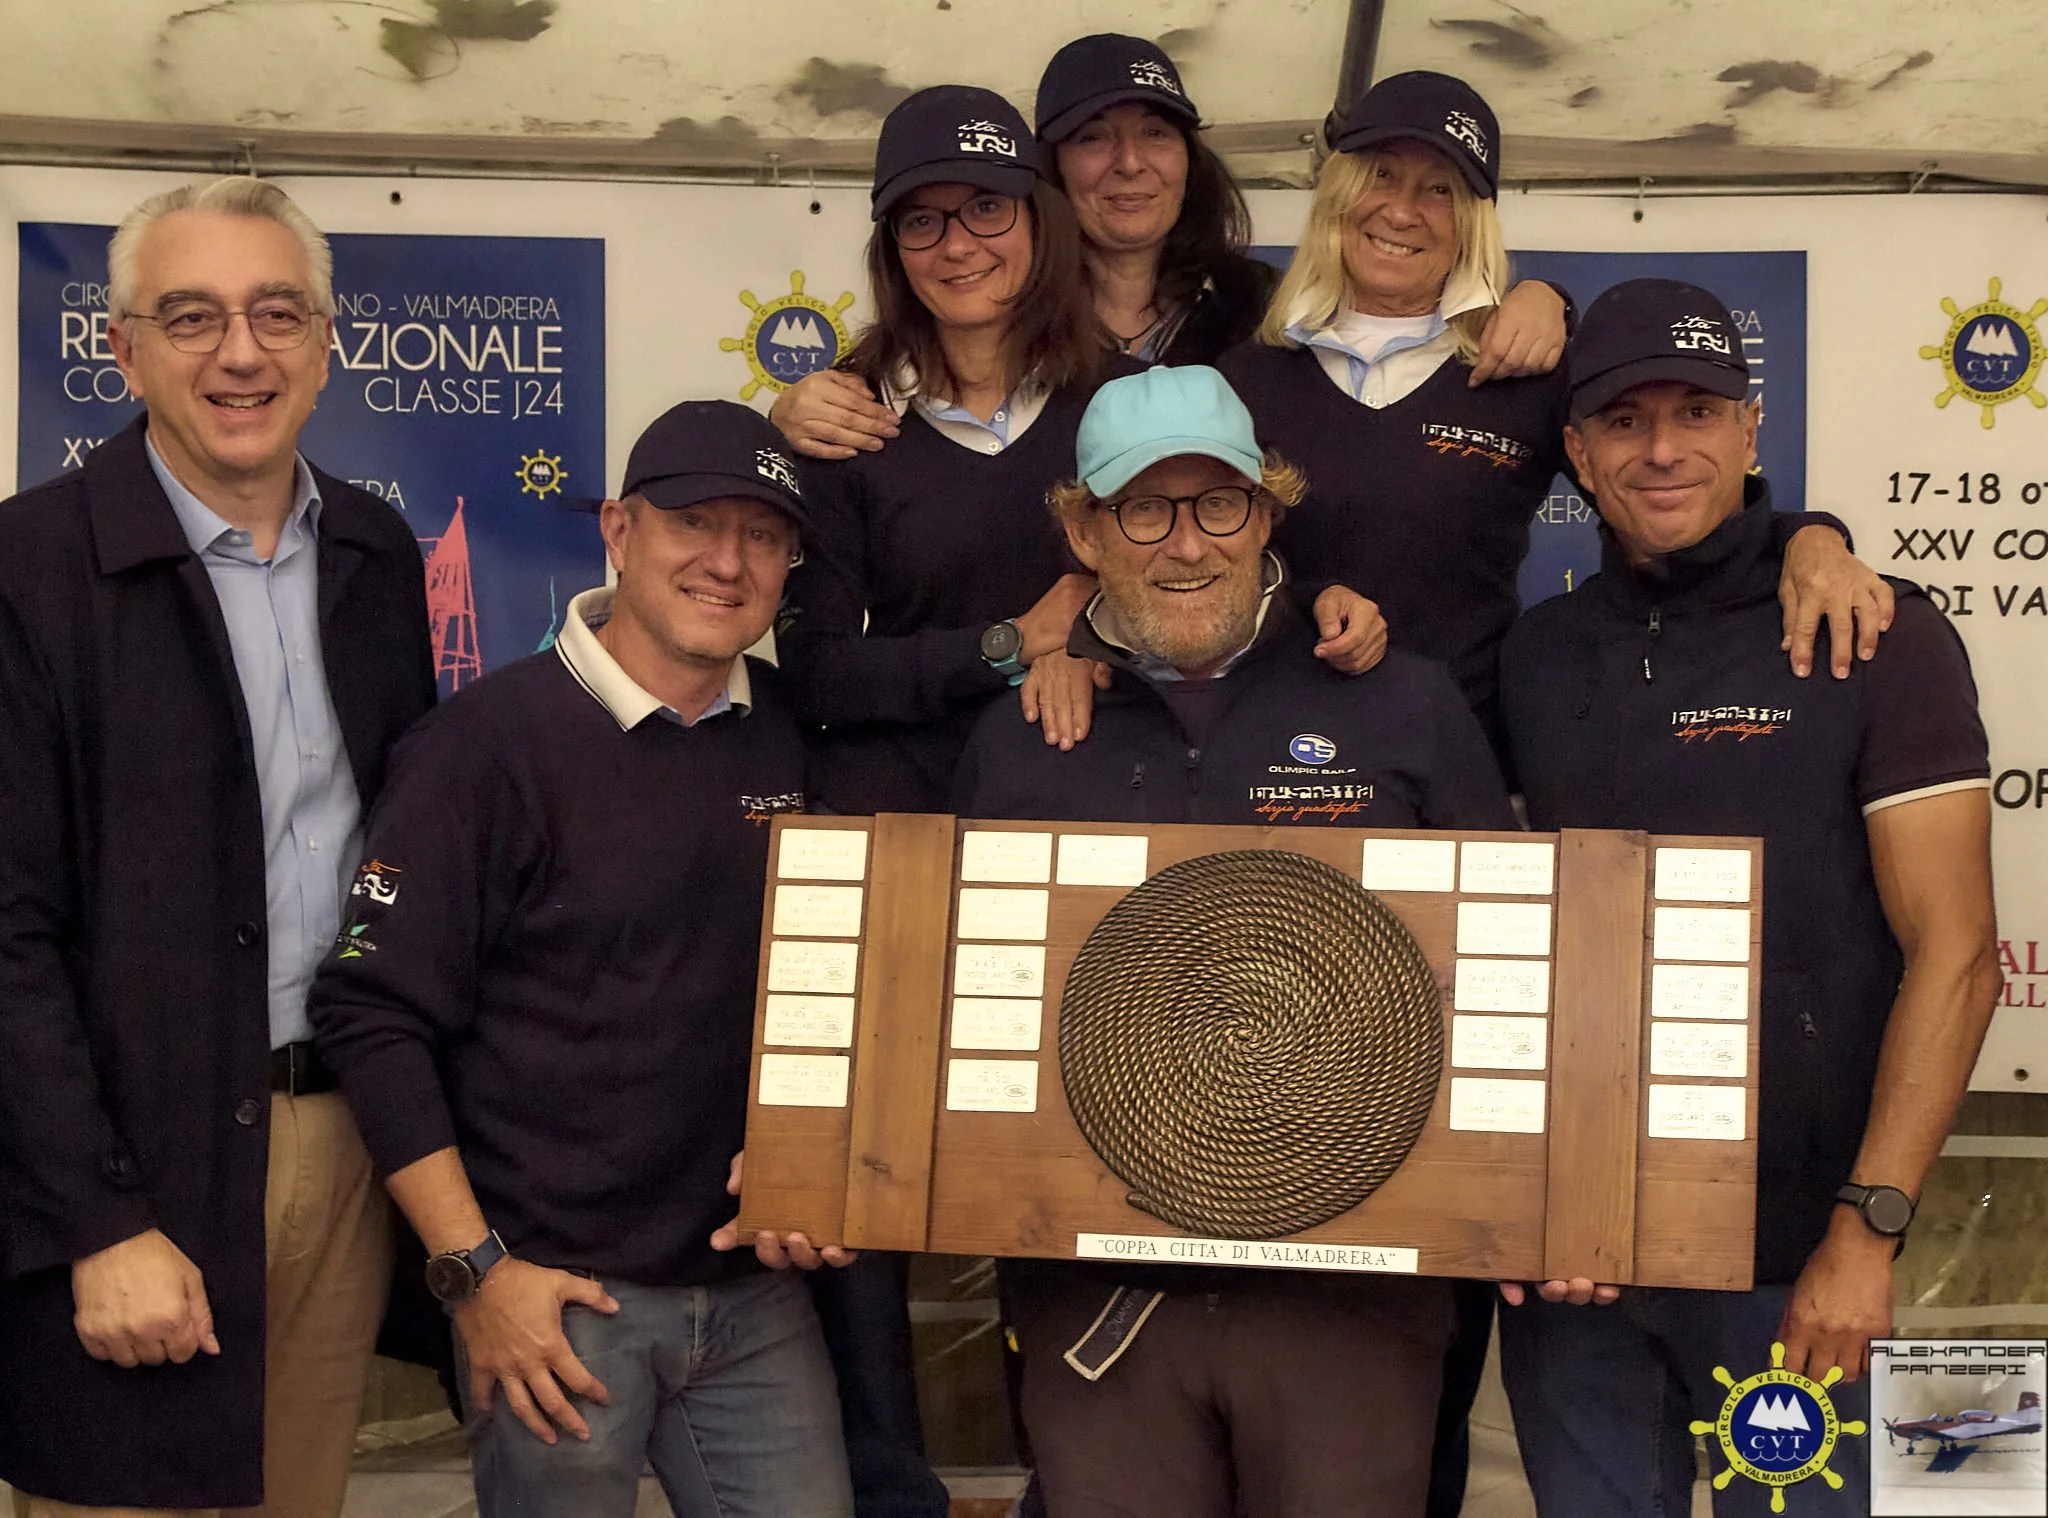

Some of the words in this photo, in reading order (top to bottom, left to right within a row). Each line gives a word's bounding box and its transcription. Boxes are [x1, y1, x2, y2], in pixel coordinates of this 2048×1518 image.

[403, 295, 560, 320] VALMADRERA
[63, 366, 135, 403] CO
[364, 376, 500, 413] CLASSE
[512, 380, 564, 420] J24
[1888, 472, 2001, 504] 17-18
[1892, 529, 1974, 560] XXV
[1993, 529, 2048, 560] CO
[1993, 585, 2048, 616] VA
[1268, 765, 1319, 775] OLIMPIC
[1996, 982, 2046, 1008] LL
[1232, 1245, 1250, 1260] DI
